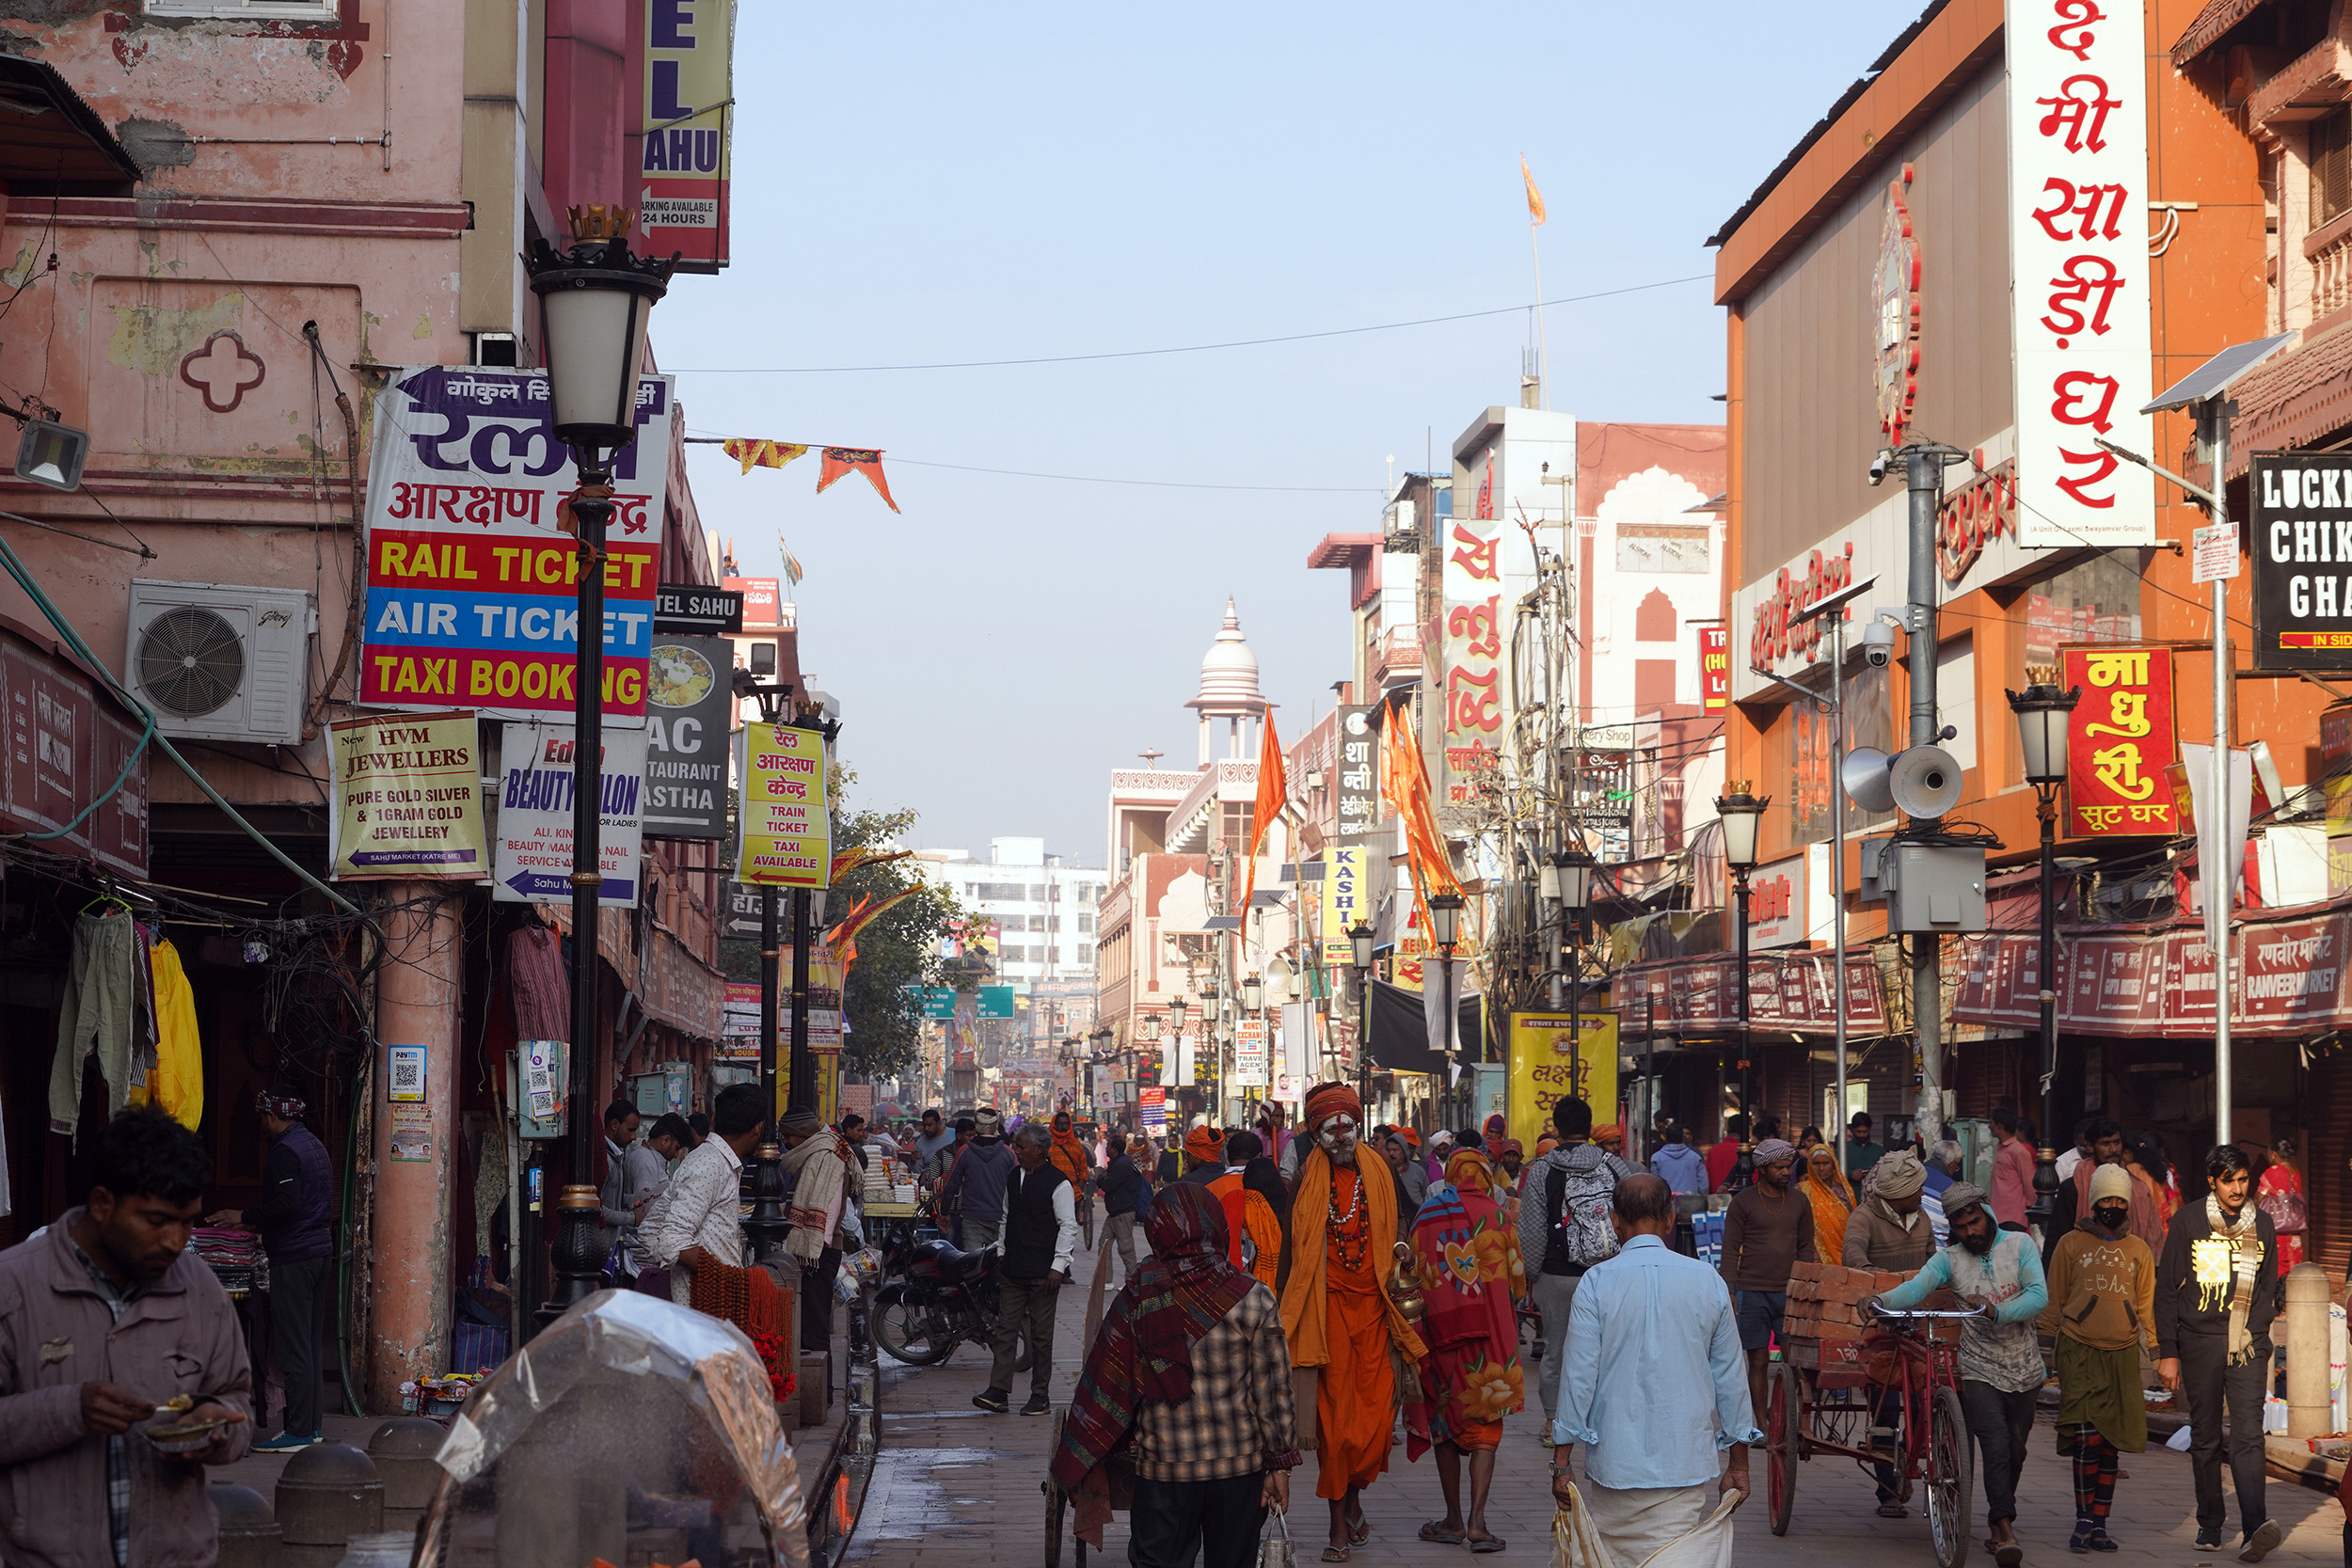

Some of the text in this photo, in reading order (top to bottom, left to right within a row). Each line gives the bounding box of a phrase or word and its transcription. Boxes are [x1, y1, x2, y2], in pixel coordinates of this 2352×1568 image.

[644, 129, 717, 172] AHU
[672, 200, 713, 213] AVAILABLE
[643, 214, 706, 225] 24 HOURS
[2031, 177, 2128, 350] साड़ी
[448, 376, 519, 405] गोकुल
[2051, 370, 2120, 509] घर
[388, 482, 544, 528] आरक्षण
[2123, 525, 2146, 533] Group)
[379, 542, 651, 588] RAIL TICKET
[689, 596, 736, 617] SAHU
[258, 610, 293, 627] Godrej
[376, 601, 647, 644] AIR TICKET
[2313, 635, 2328, 645] IN
[374, 656, 641, 705] TAXI BOOKNG
[342, 727, 431, 746] New HVM
[647, 716, 702, 753] AC
[774, 725, 799, 748] रेल
[1573, 728, 1630, 743] Bkery Shop
[2086, 652, 2154, 800] माधुरी
[345, 748, 469, 779] JEWELLERS
[756, 754, 816, 775] आरक्षण
[348, 786, 470, 806] PURE GOLD SILVER
[505, 768, 576, 812] BEAUTY
[767, 775, 807, 800] केन्द्र
[357, 810, 367, 822] &
[428, 806, 463, 820] GOLD
[771, 806, 805, 817] TRAIN
[2077, 804, 2169, 832] सूट घर
[373, 826, 449, 840] JEWELLERY
[767, 821, 809, 833] TICKET
[508, 841, 544, 851] BEAUTY
[605, 847, 628, 857] NAIL
[773, 841, 800, 852] TAXI
[517, 855, 560, 866] SERVICE
[753, 856, 818, 868] AVAILABLE
[534, 878, 560, 889] Sahu
[1335, 850, 1356, 924] KASHI
